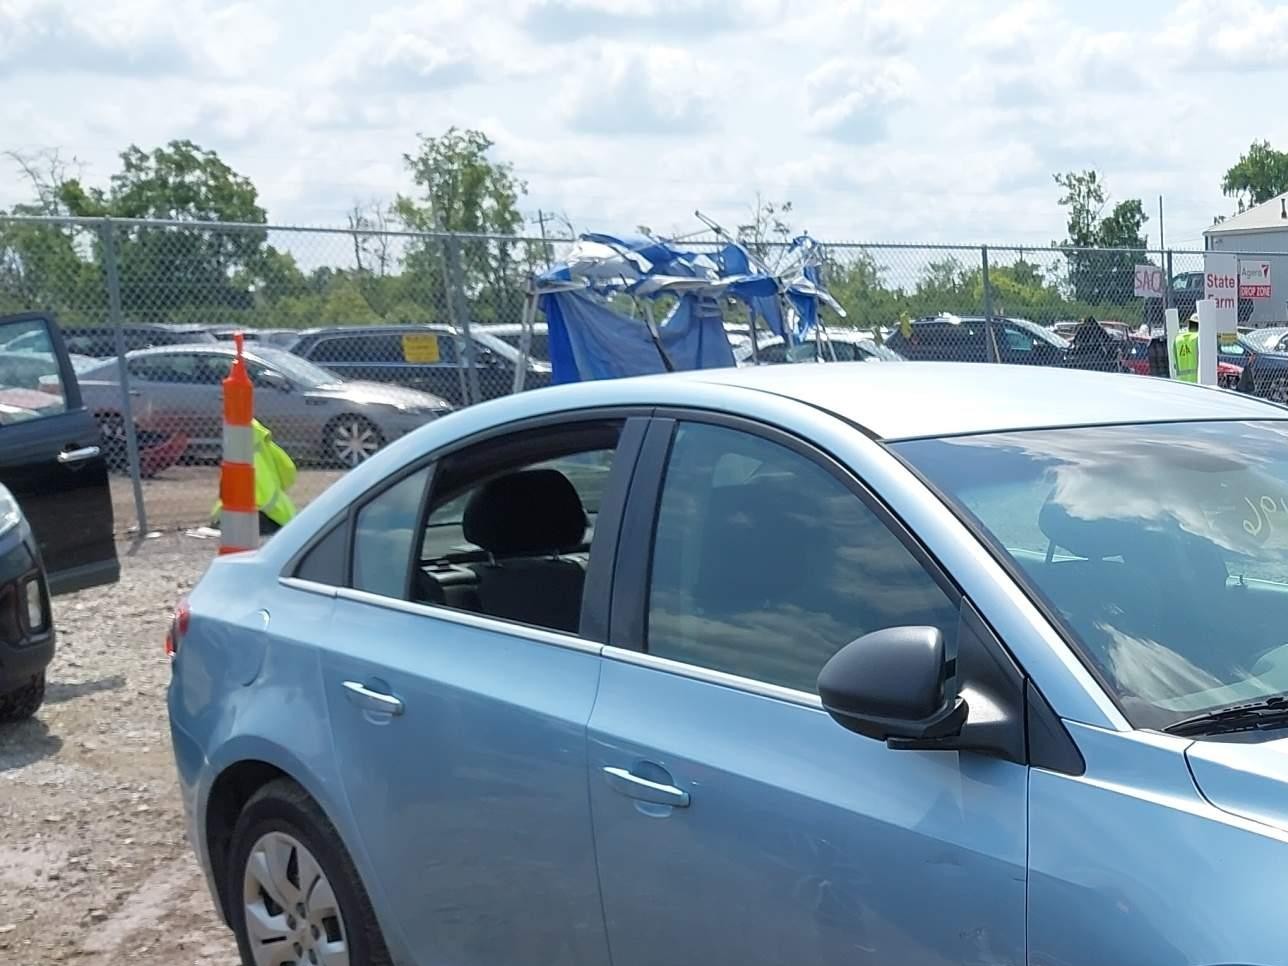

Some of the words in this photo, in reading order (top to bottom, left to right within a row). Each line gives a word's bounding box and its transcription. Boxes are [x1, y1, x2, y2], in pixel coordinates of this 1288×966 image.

[1206, 273, 1235, 288] State
[1241, 286, 1256, 297] DROP
[1256, 286, 1271, 297] ZONE
